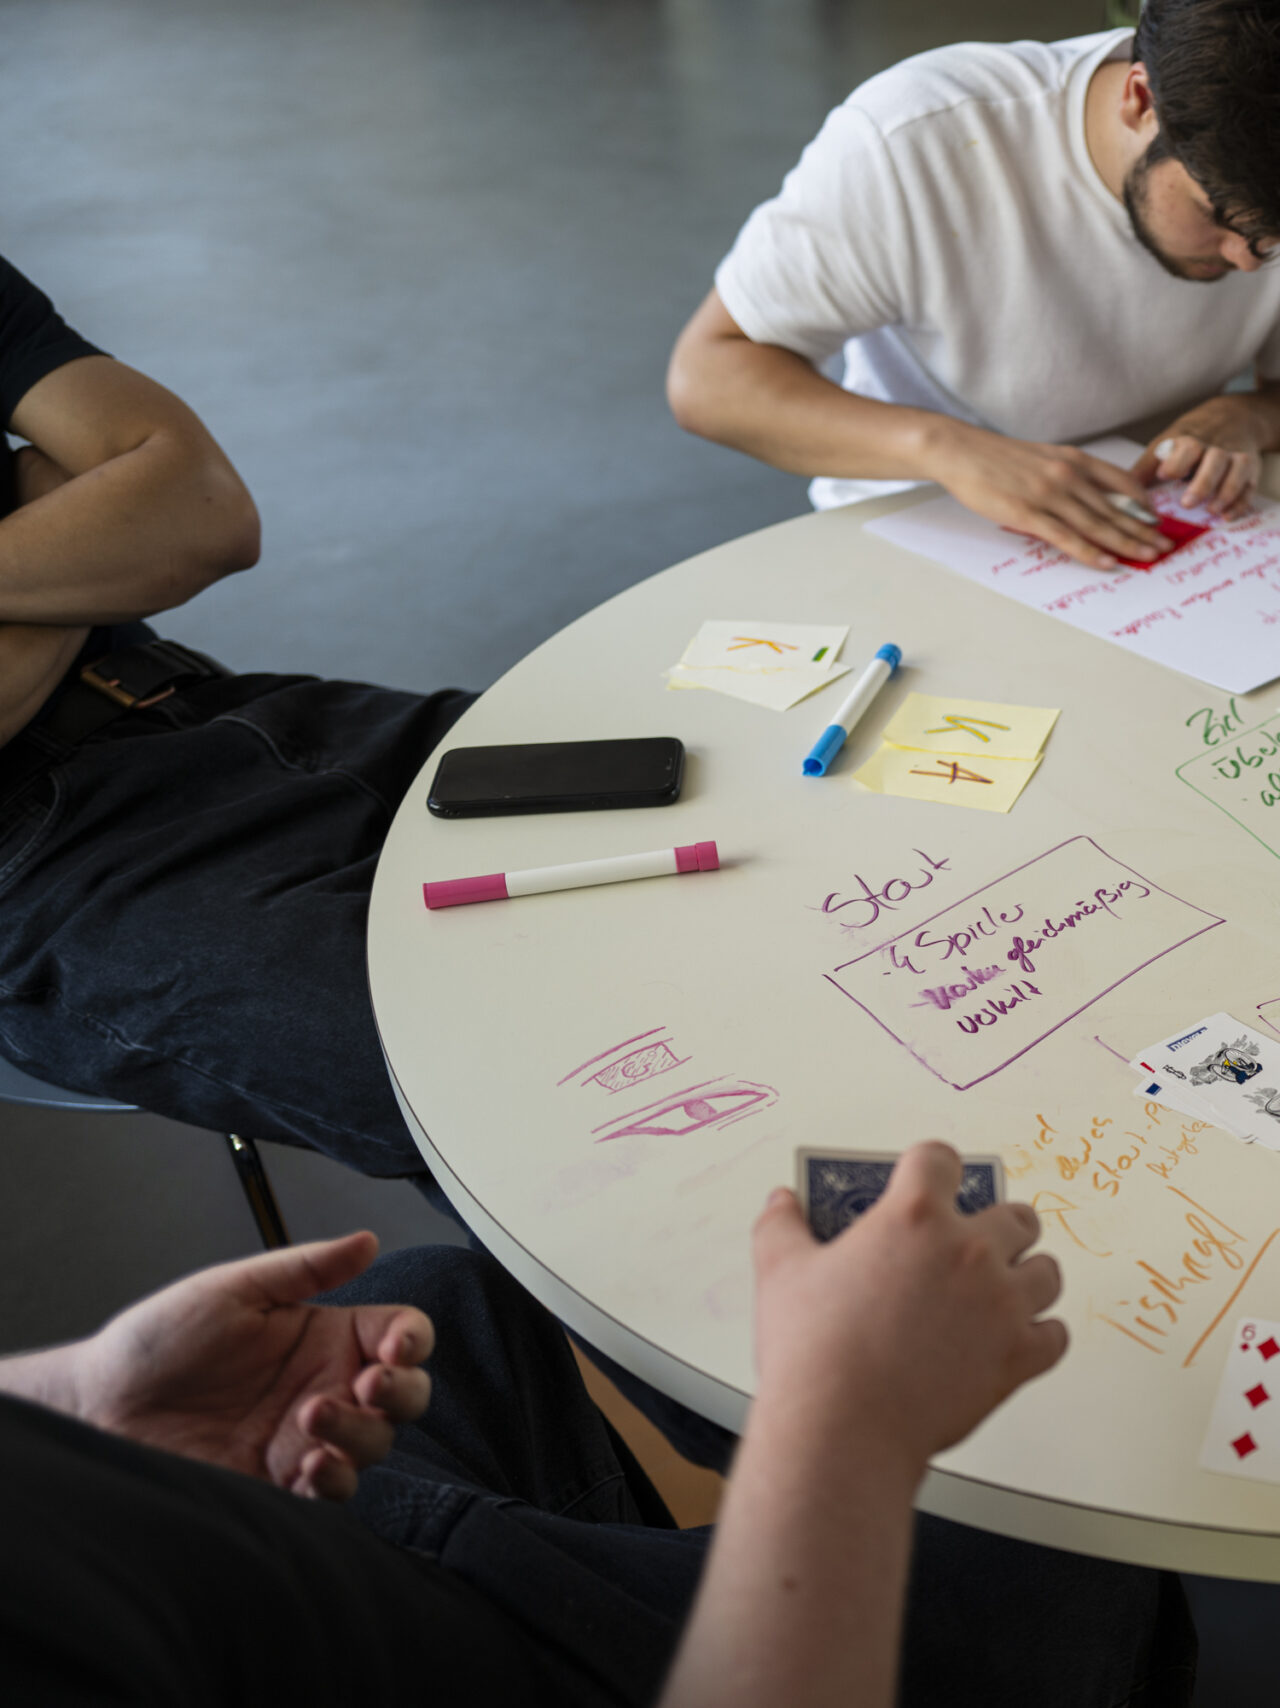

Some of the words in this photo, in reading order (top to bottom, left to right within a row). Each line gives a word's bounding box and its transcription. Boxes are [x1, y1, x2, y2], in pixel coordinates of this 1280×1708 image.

[1186, 698, 1245, 745] Ziel
[909, 759, 995, 785] A
[821, 848, 952, 929] Start
[1241, 1323, 1256, 1341] 6
